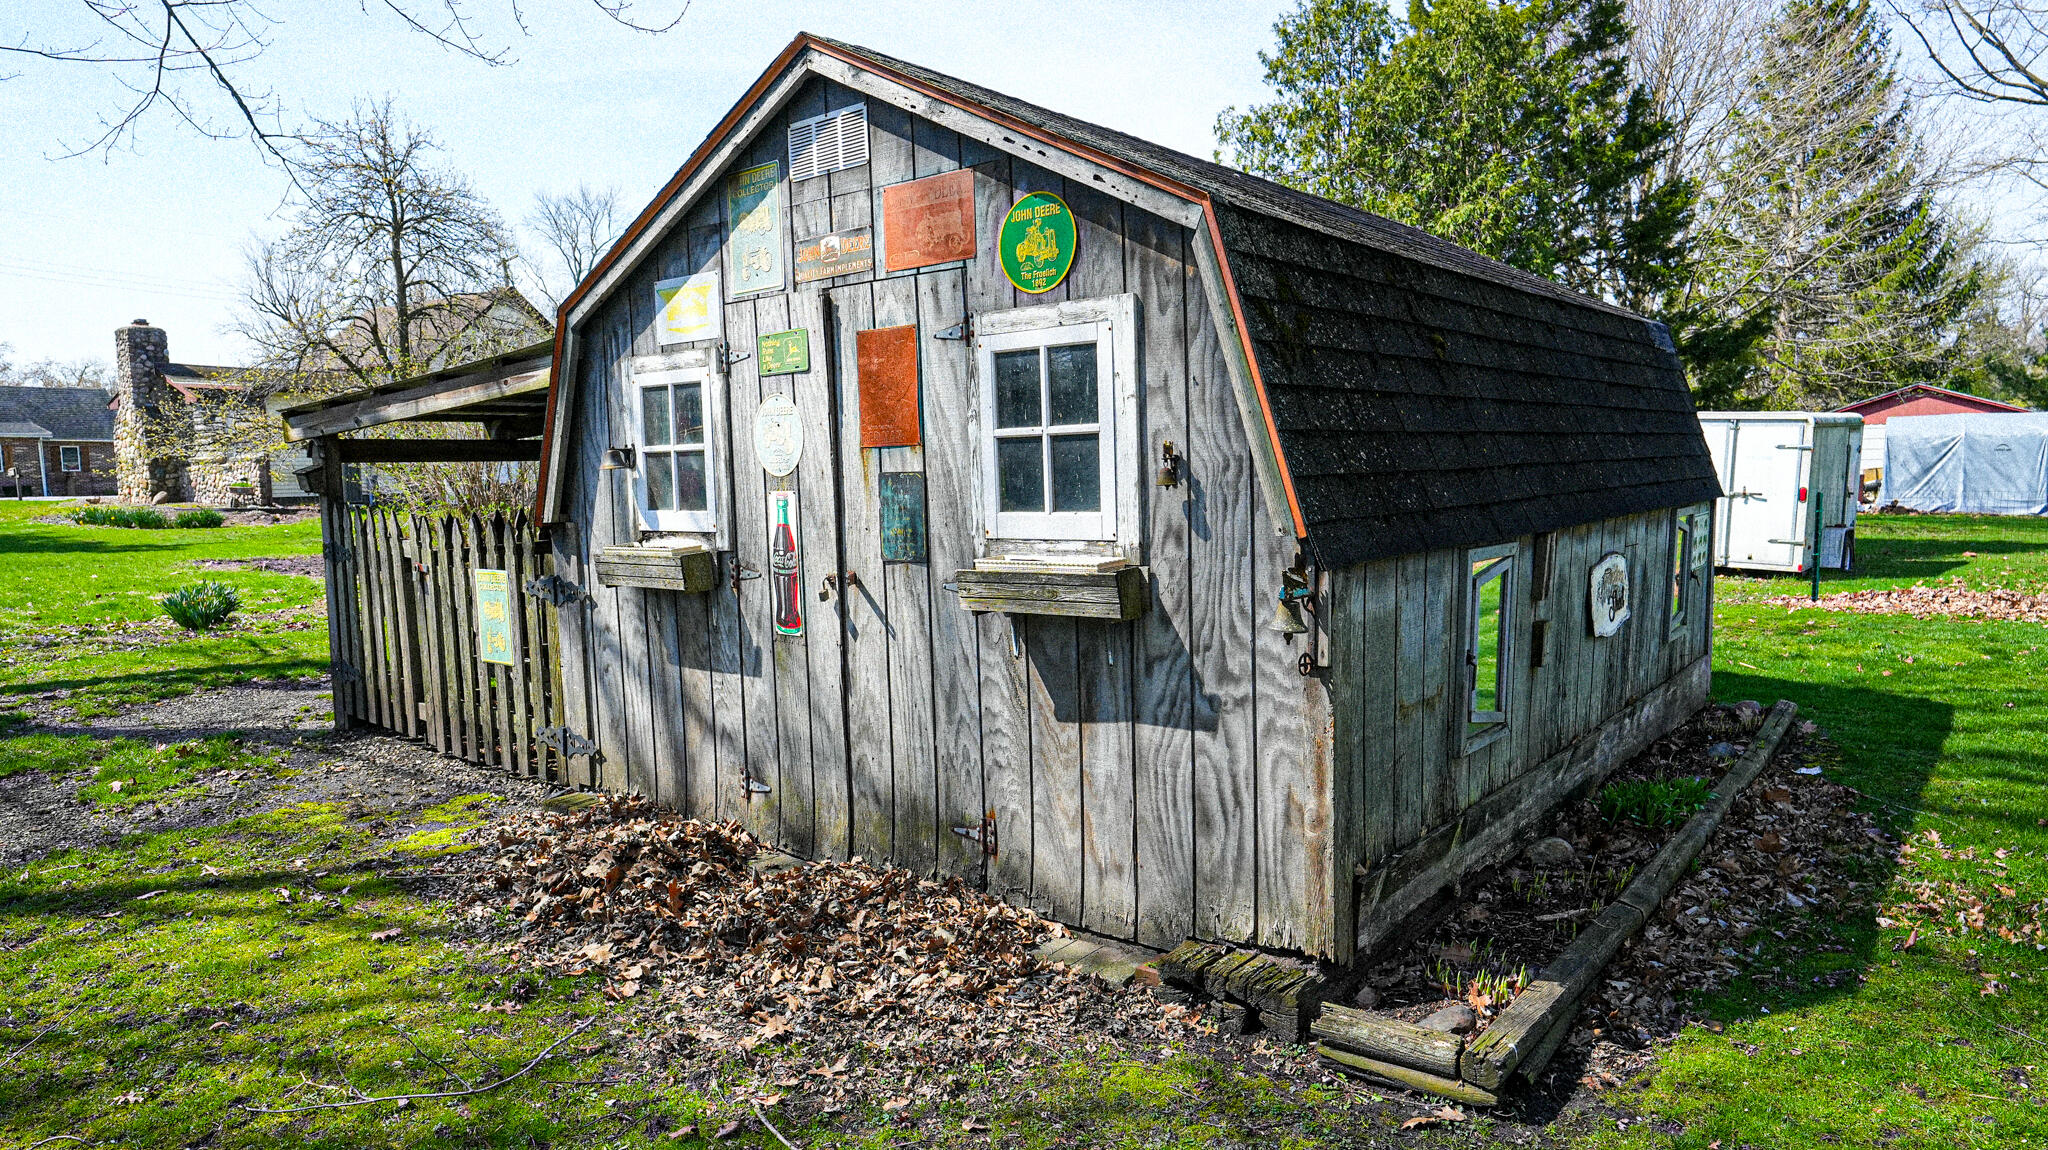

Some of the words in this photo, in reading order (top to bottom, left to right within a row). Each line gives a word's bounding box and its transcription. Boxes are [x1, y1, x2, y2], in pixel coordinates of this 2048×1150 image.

[751, 166, 777, 184] DEERE
[733, 181, 775, 198] COLLECTOR
[1011, 207, 1033, 223] JOHN
[1034, 202, 1061, 218] DEERE
[797, 244, 821, 263] JOHN
[840, 234, 871, 254] DEERE
[821, 264, 835, 276] FARM
[835, 258, 873, 273] IMPLEMENTS
[1021, 271, 1032, 280] The
[1033, 267, 1057, 279] Froelich
[1032, 278, 1047, 288] 1892
[762, 339, 780, 347] Nothing
[762, 347, 775, 355] Runs
[776, 405, 794, 416] DEERE
[491, 574, 506, 584] DEERE
